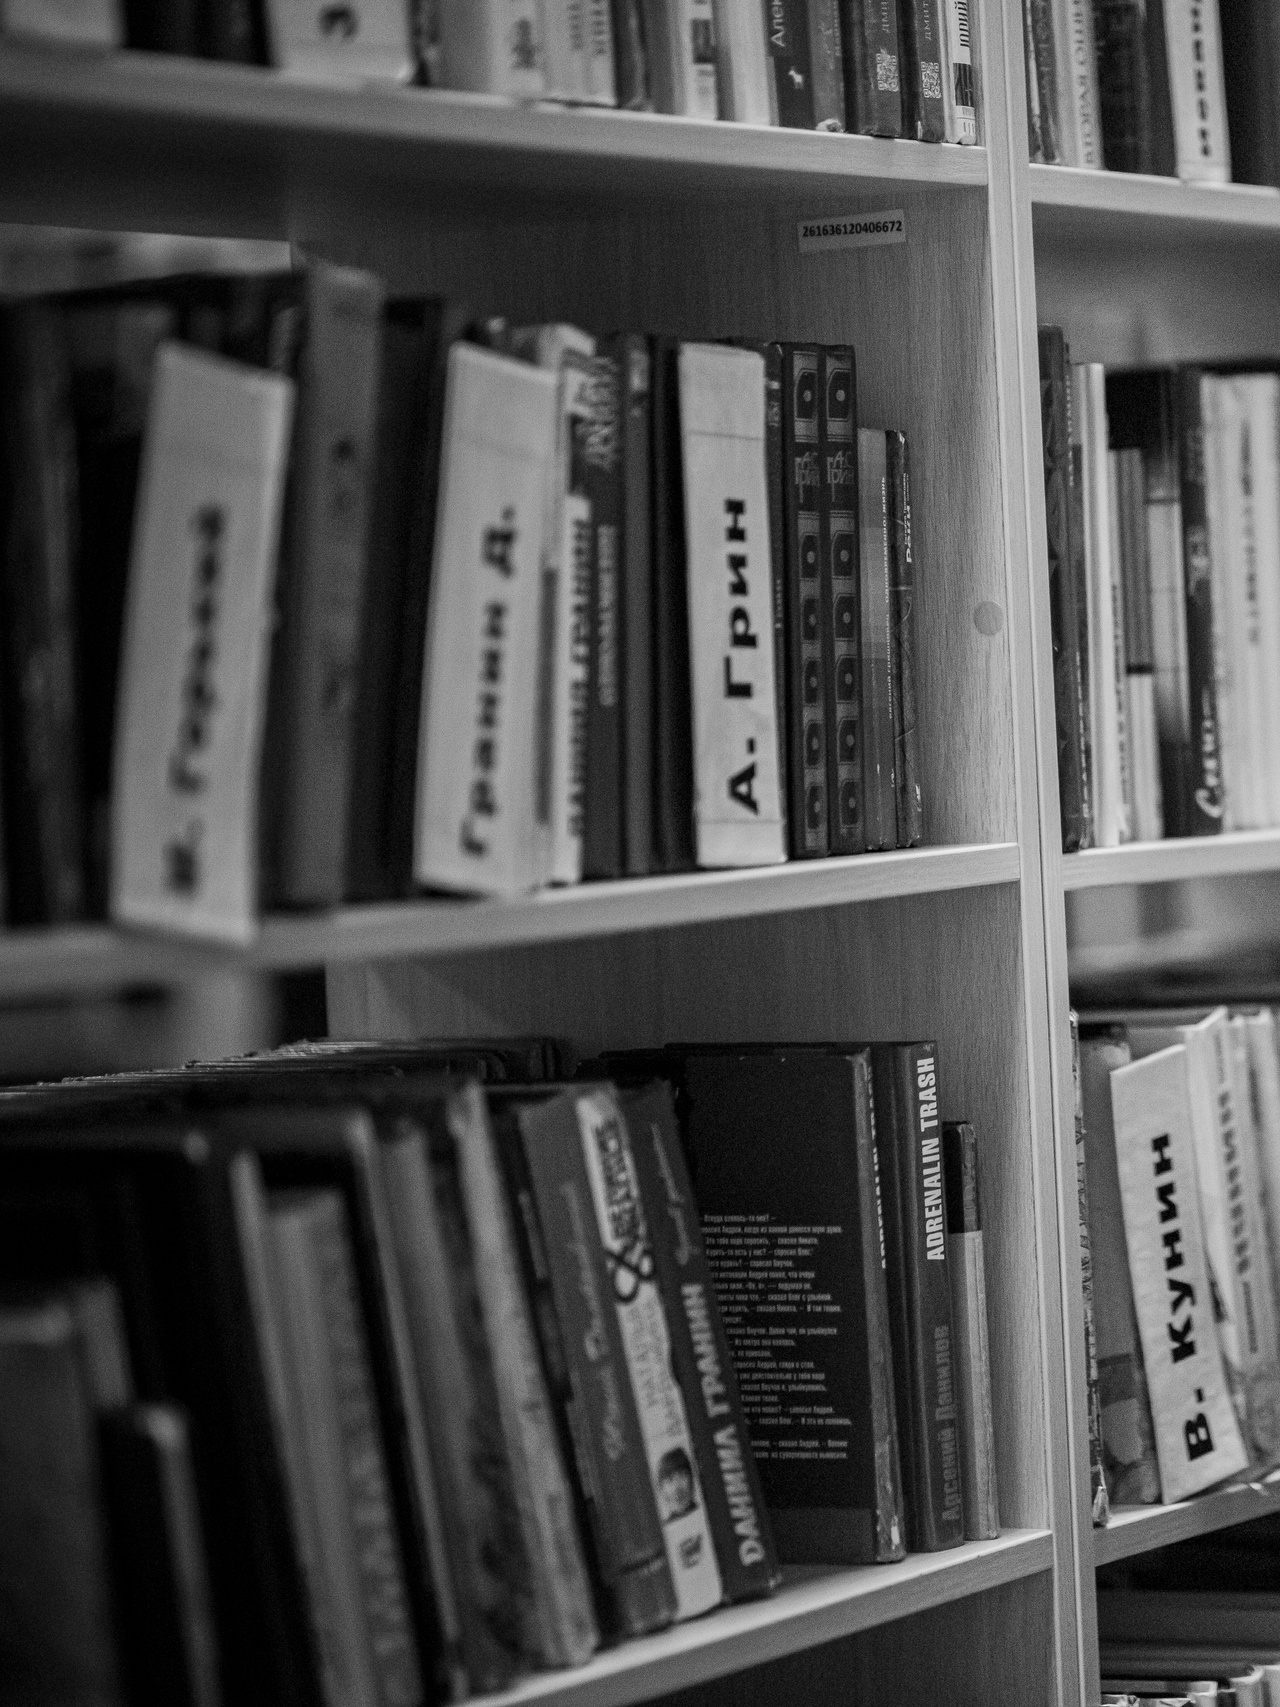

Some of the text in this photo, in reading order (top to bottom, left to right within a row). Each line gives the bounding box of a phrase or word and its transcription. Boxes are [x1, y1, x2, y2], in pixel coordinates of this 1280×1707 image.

[802, 220, 902, 238] 261636120406672
[724, 499, 759, 815] А. Грин
[916, 1057, 945, 1261] ADRENALIN TRASH
[680, 1283, 731, 1419] ГРАНИН
[932, 1324, 958, 1421] Данилов
[1151, 1132, 1215, 1462] В. Кунин
